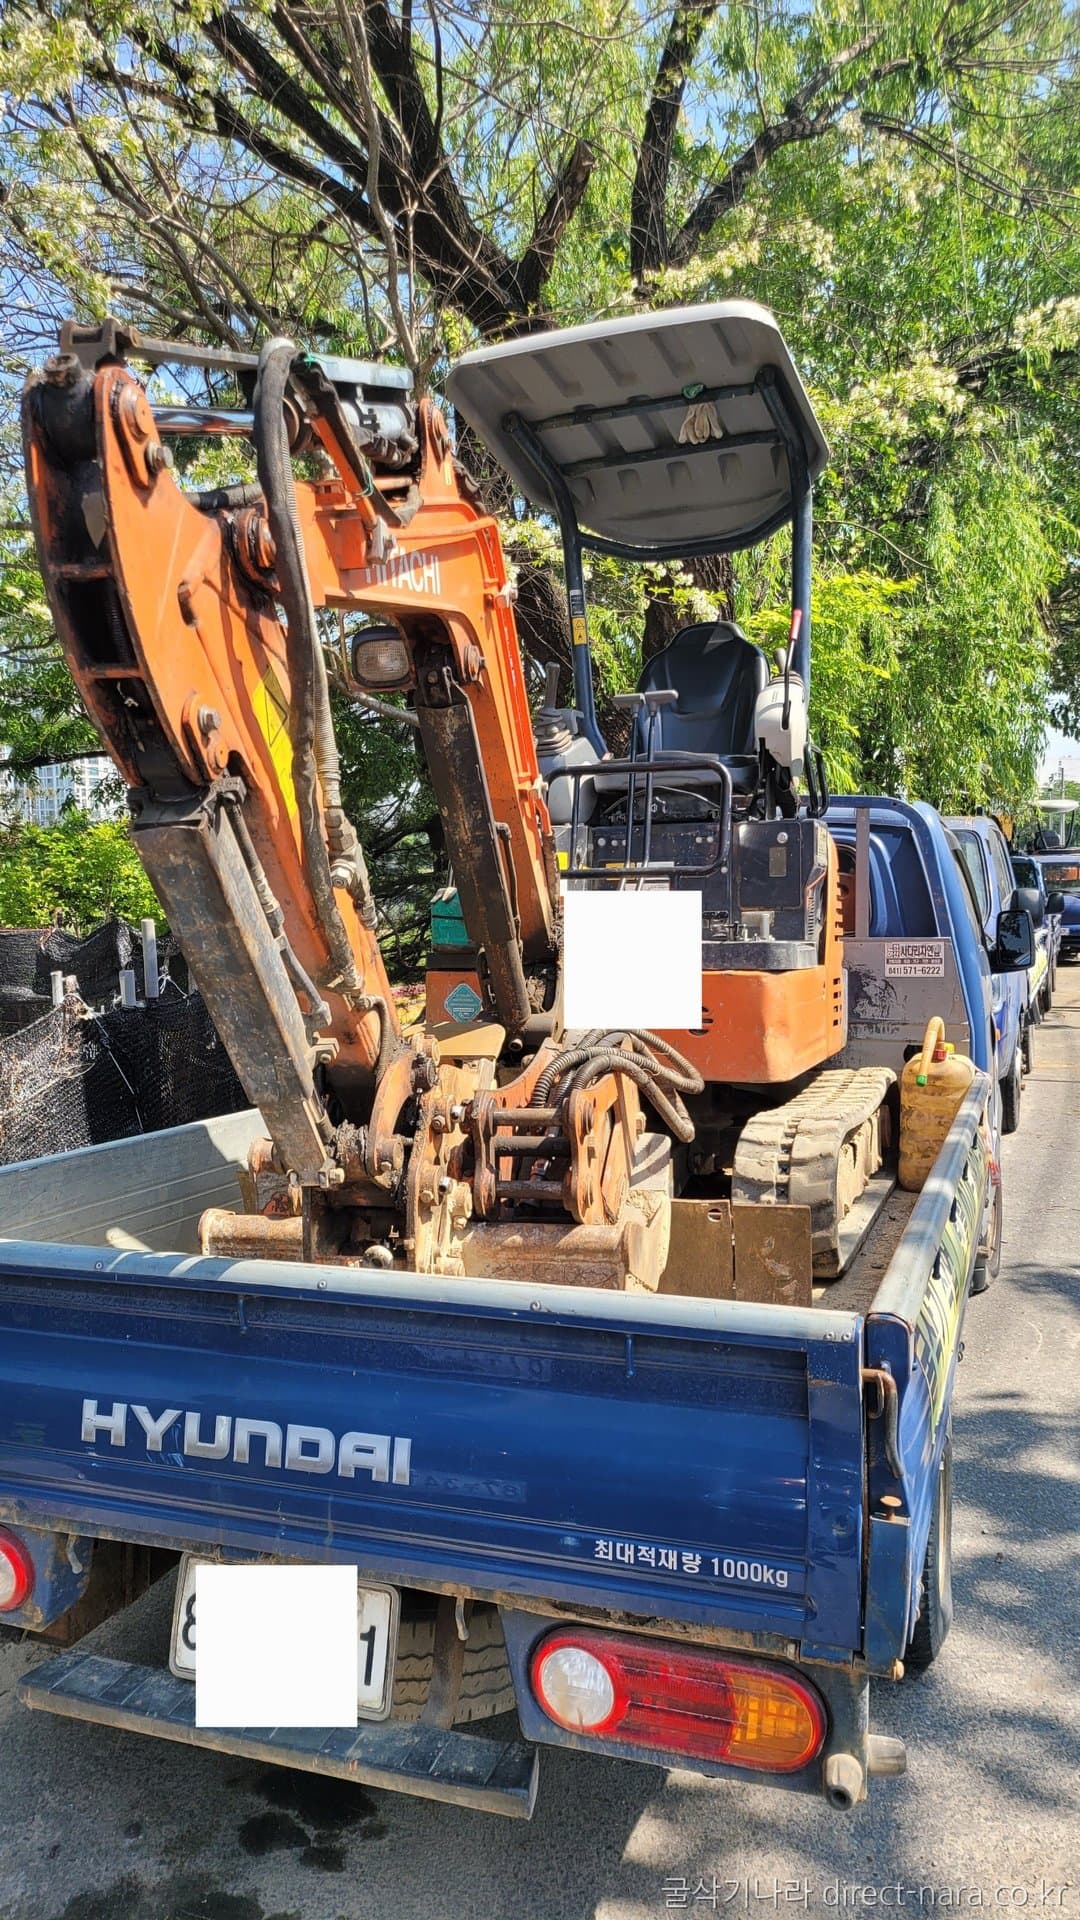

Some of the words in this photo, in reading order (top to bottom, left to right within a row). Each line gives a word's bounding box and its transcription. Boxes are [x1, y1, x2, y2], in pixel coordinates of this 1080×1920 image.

[903, 966, 941, 975] 571-6222
[81, 1399, 413, 1486] HYUNDAI
[594, 1539, 702, 1575] 최대적재량
[711, 1557, 789, 1588] 1000kg
